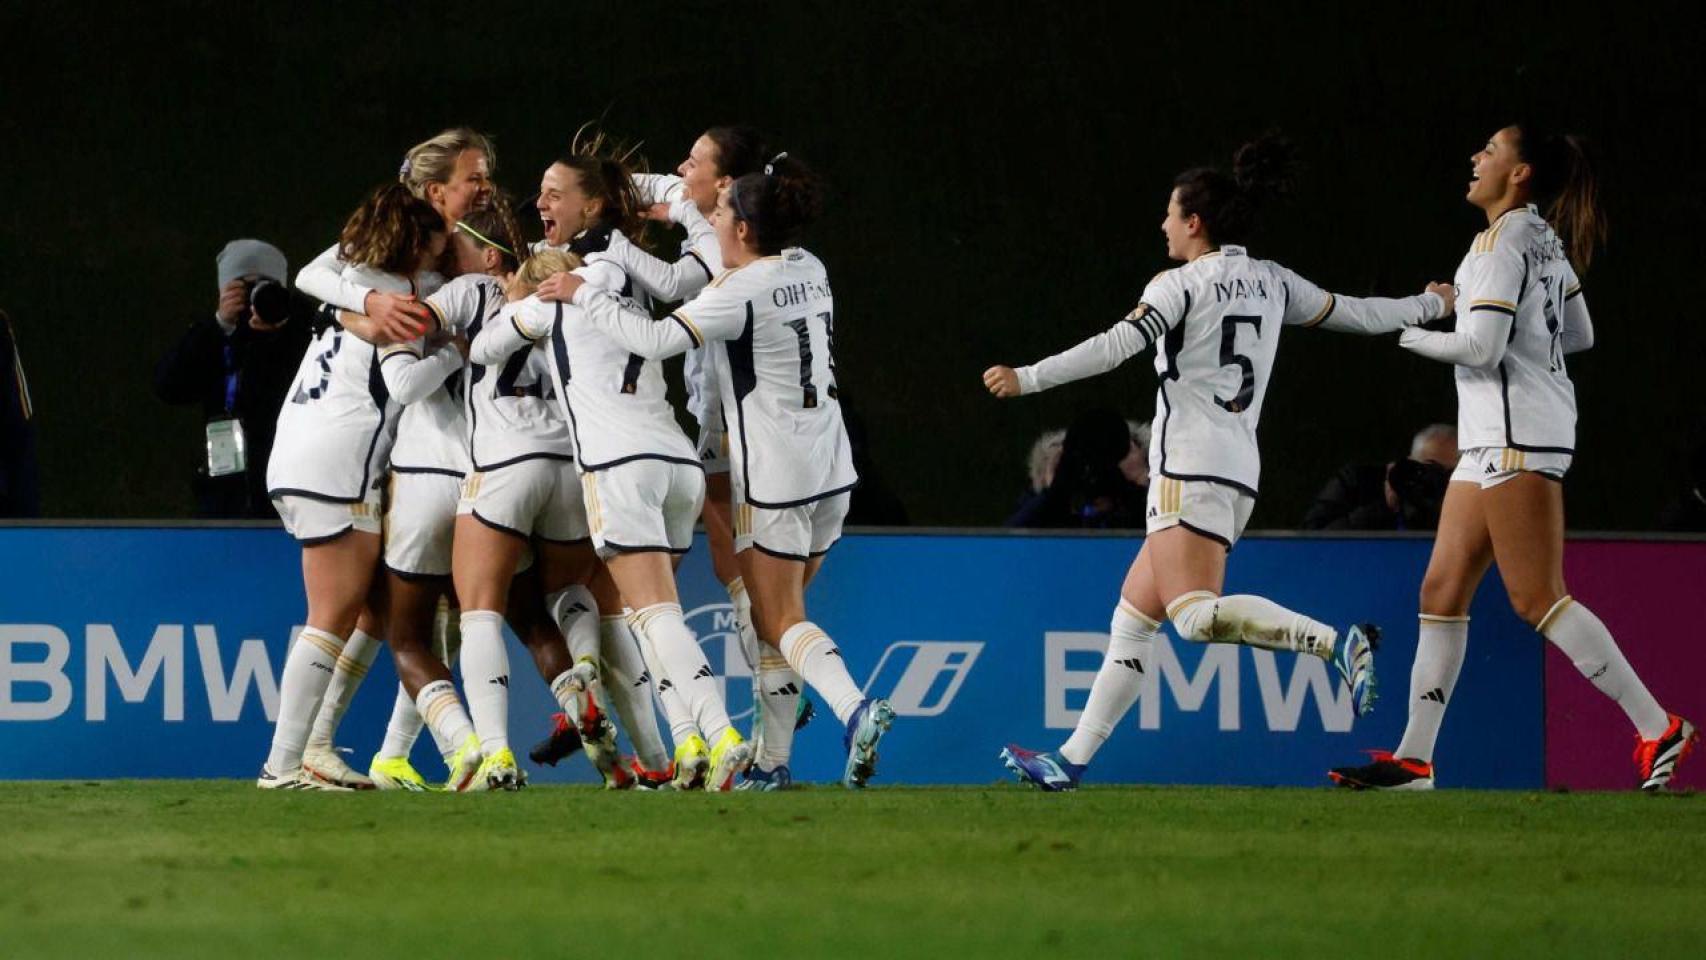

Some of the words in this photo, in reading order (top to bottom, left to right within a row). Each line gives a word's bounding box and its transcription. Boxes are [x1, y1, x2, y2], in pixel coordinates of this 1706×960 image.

[1214, 315, 1263, 413] 5
[0, 624, 306, 722] BMW
[1045, 631, 1357, 733] BMW
